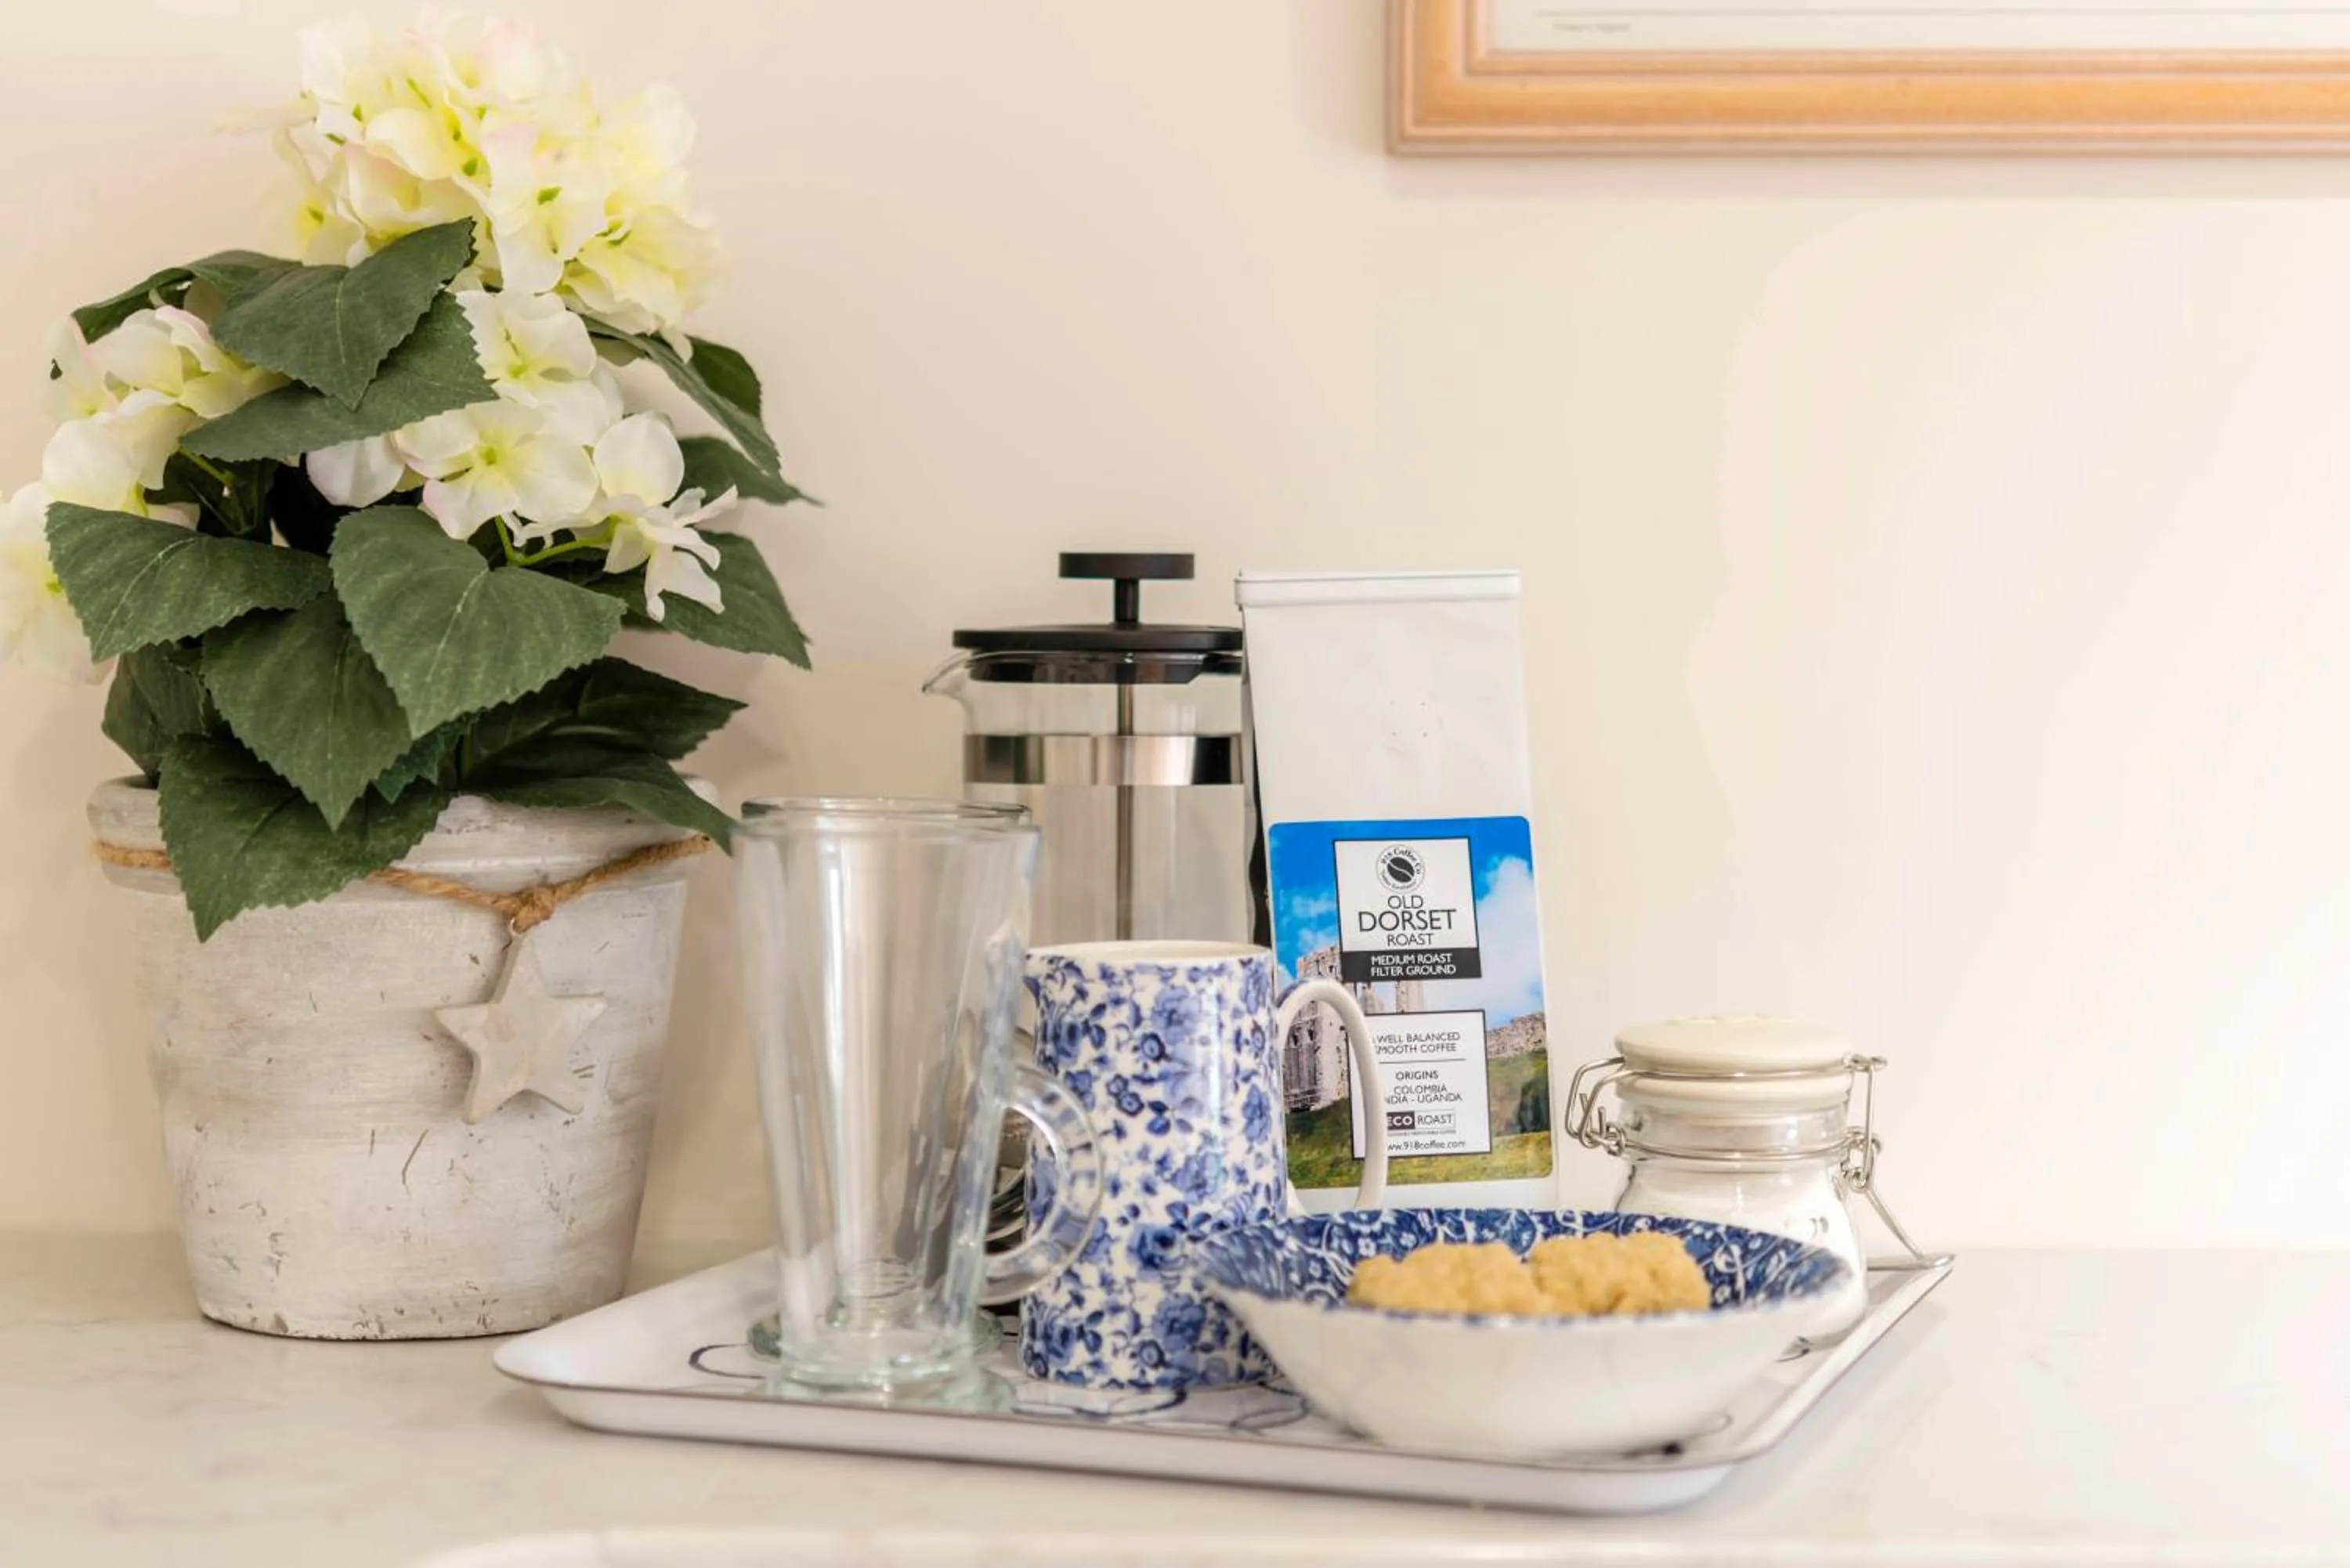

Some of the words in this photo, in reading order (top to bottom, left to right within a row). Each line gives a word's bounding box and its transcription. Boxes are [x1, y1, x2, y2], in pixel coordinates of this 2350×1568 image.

[1387, 895, 1423, 909] OLD
[1358, 909, 1456, 932] DORSET
[1386, 933, 1434, 946] ROAST
[1371, 954, 1415, 966] MEDIUM
[1417, 952, 1453, 964] ROAST
[1371, 966, 1404, 977] FILTER
[1406, 964, 1456, 975] GROUND
[1377, 1035, 1404, 1044] WELL
[1406, 1031, 1460, 1042] BALANCED
[1420, 1042, 1458, 1053] COFFEE
[1395, 1070, 1439, 1081] ORIGINS
[1394, 1085, 1447, 1095] COLOMBIA
[1384, 1095, 1408, 1105] NDIA
[1417, 1093, 1462, 1104] UGANDA
[1417, 1114, 1453, 1125] ROAST
